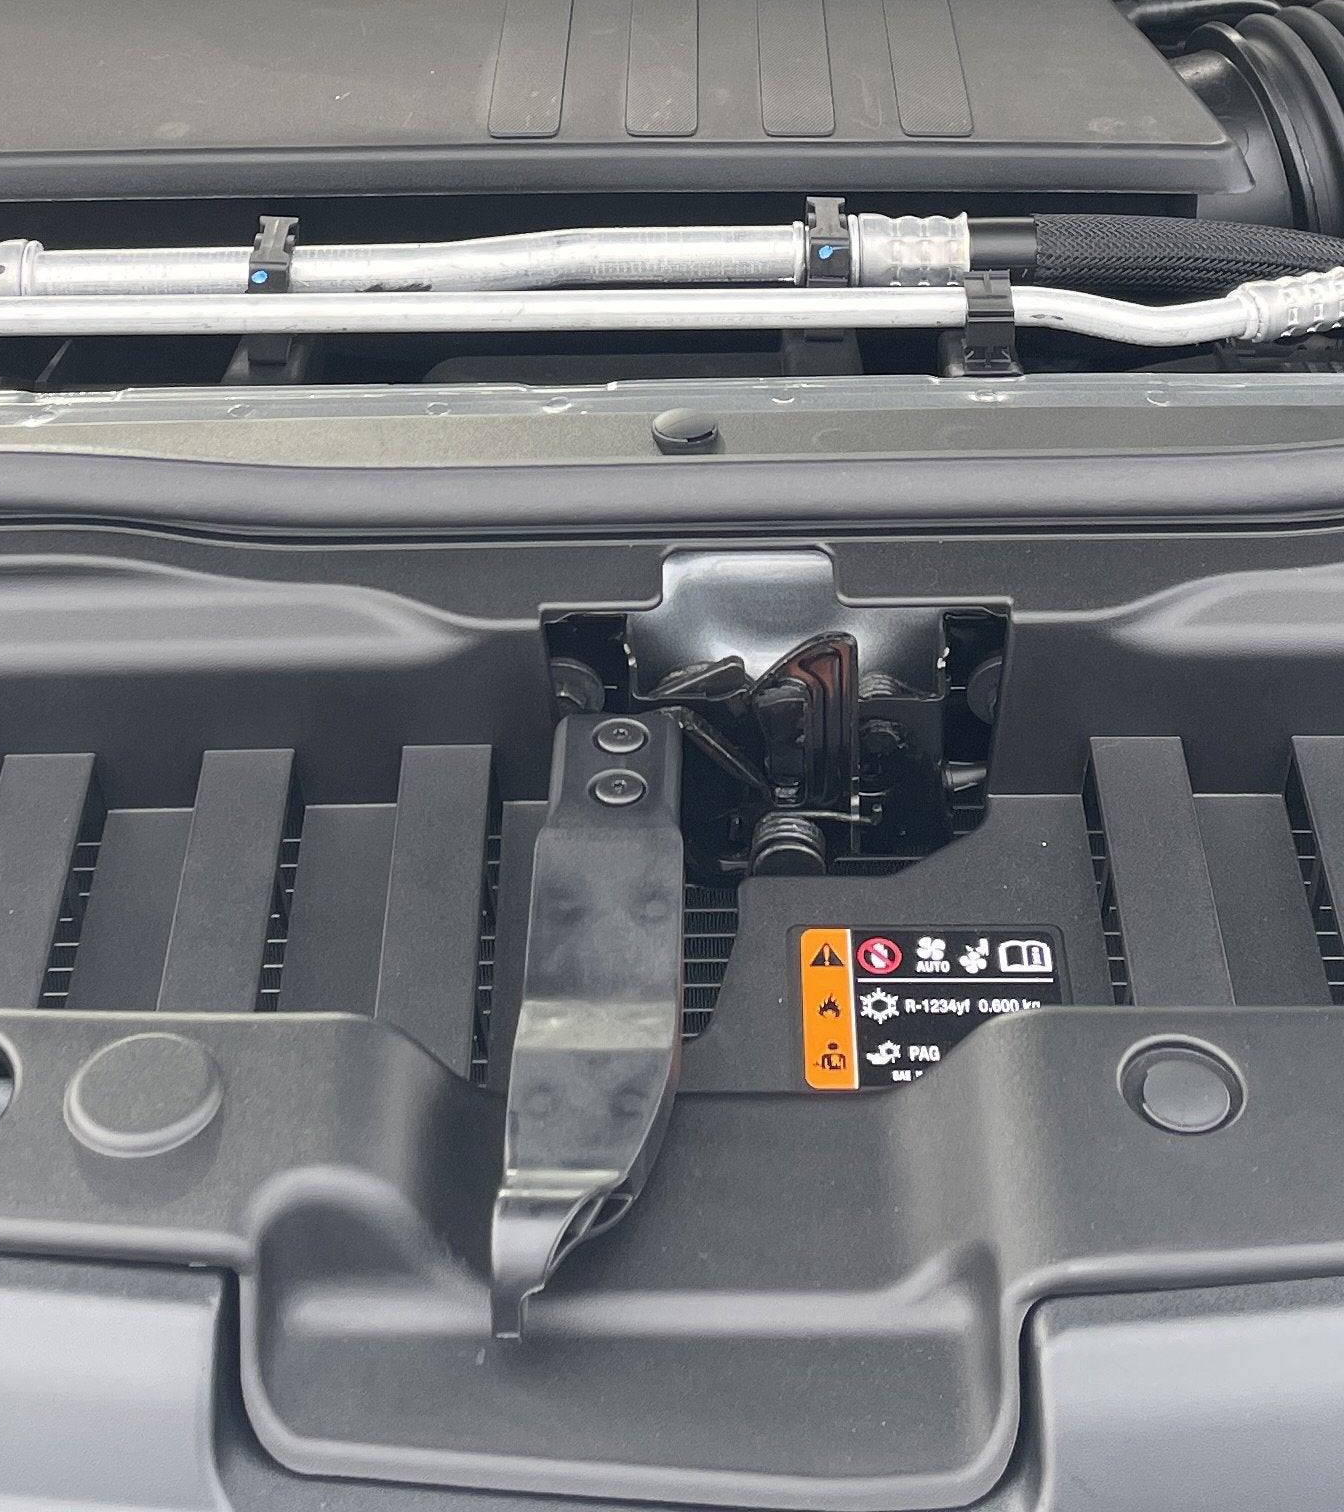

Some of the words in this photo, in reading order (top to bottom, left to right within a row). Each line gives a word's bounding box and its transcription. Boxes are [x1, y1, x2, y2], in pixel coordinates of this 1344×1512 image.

[916, 960, 950, 973] AUTO
[904, 998, 970, 1016] R-1234yf
[978, 999, 1019, 1014] 0.600
[909, 1045, 940, 1062] PAG
